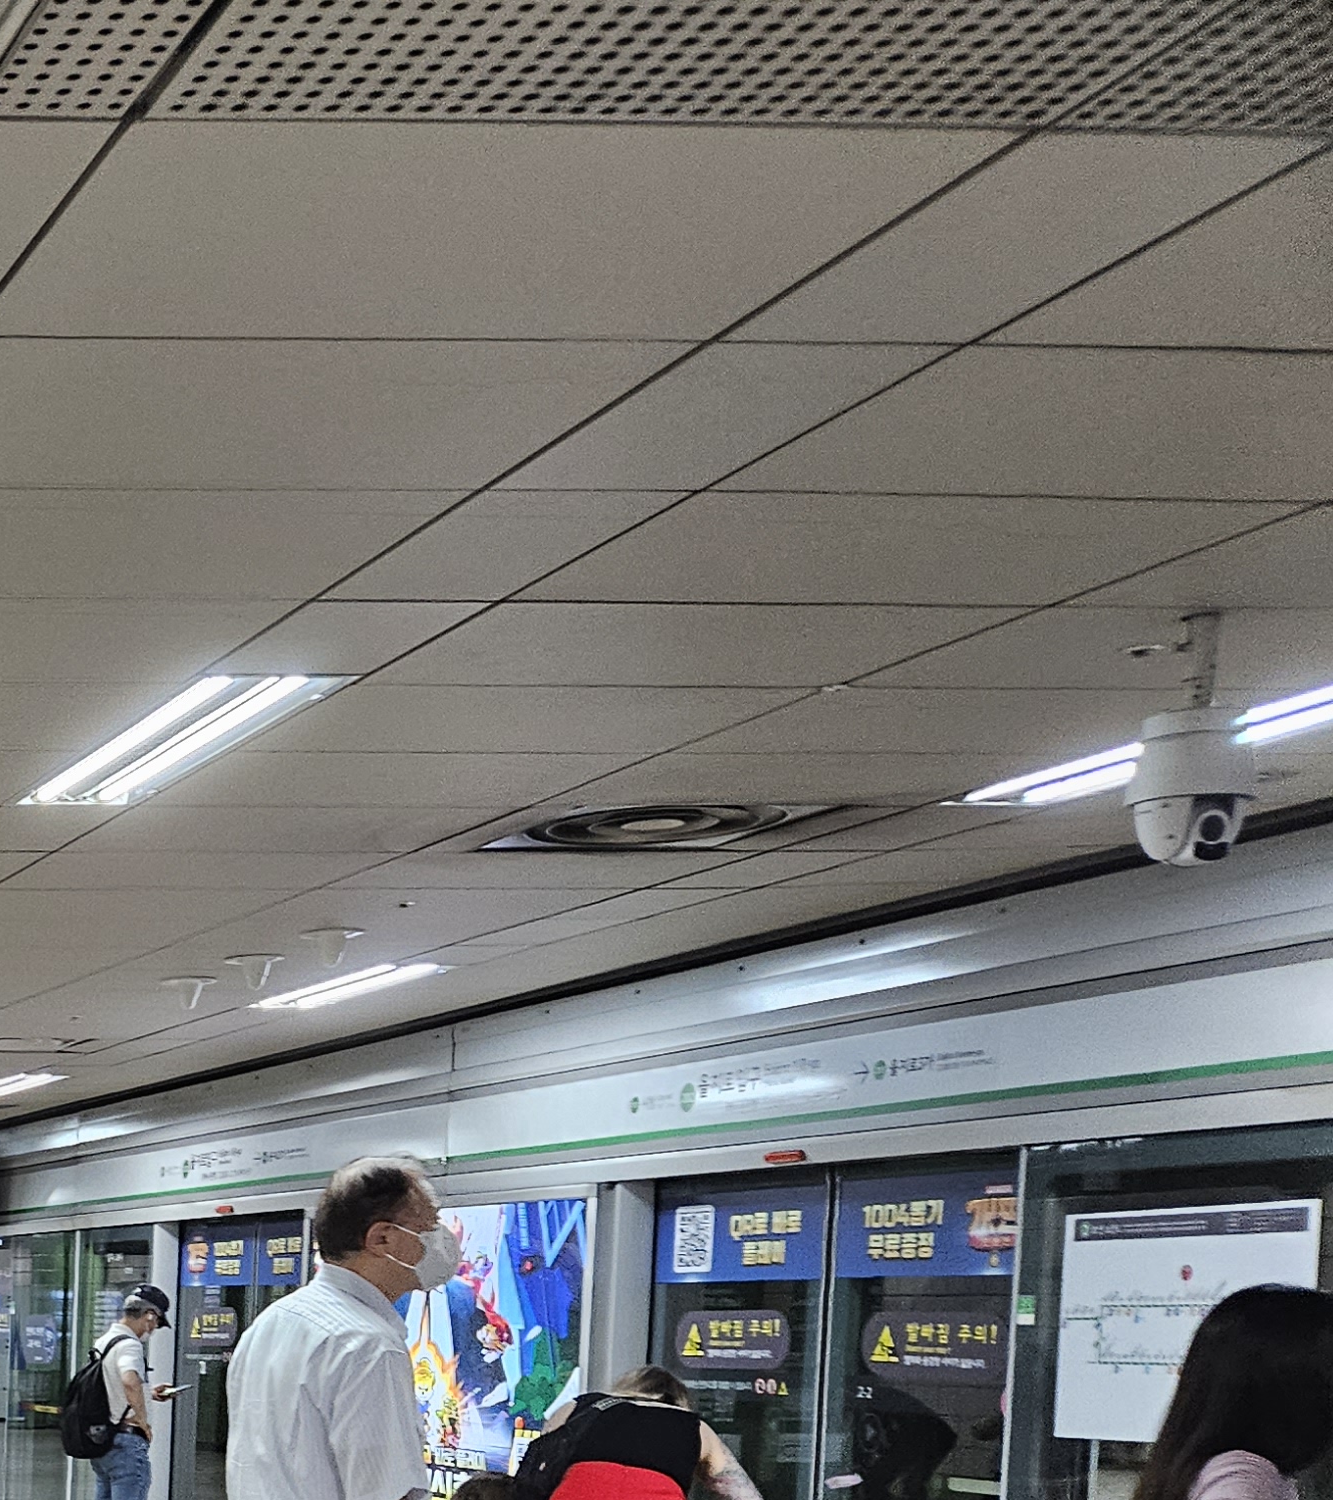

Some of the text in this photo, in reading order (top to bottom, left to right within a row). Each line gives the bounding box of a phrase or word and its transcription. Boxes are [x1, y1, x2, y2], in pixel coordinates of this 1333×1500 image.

[867, 1231, 935, 1261] 무료증정
[748, 1318, 781, 1338] 주의!
[904, 1321, 999, 1345] 발빠짐 주의!
